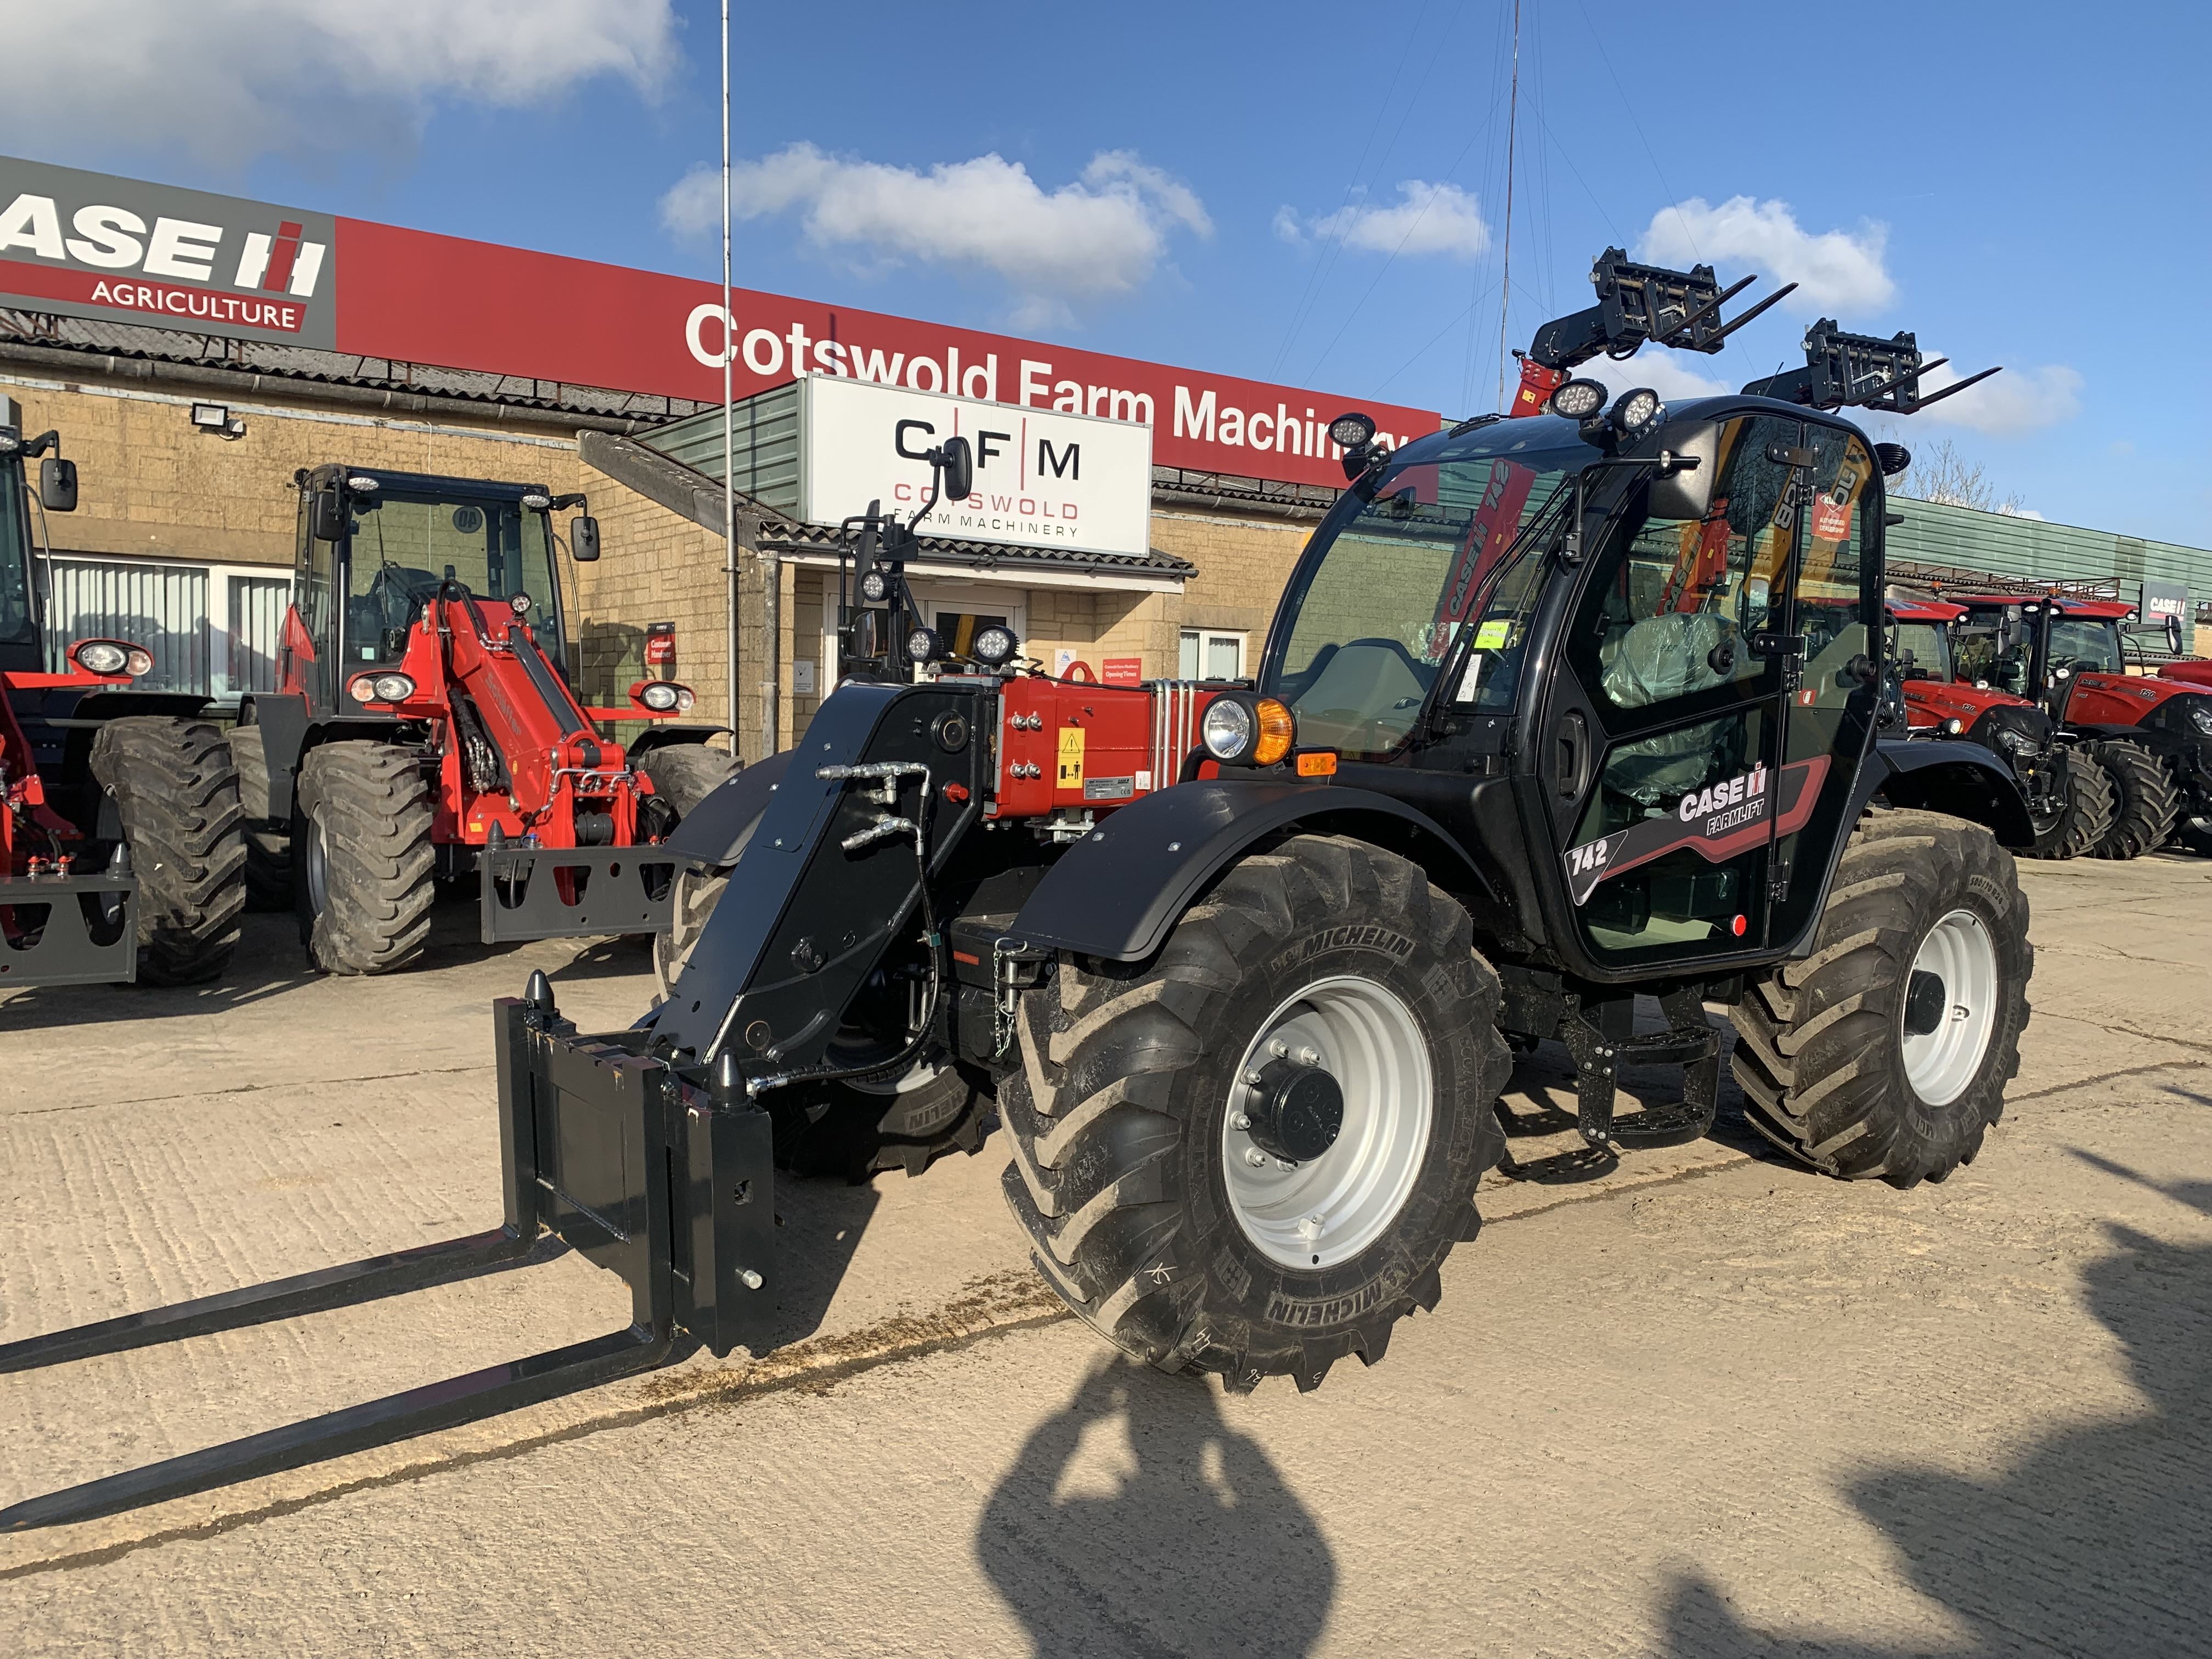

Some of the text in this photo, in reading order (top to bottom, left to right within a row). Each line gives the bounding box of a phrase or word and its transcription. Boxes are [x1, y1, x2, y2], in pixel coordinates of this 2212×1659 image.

[0, 194, 223, 281] ASE
[91, 281, 295, 328] AGRICULTURE
[895, 483, 1077, 520] COSWOLD
[961, 516, 1077, 537] MACHINERY
[1820, 525, 1844, 533] DEALERSHIP
[2150, 597, 2177, 613] CASE
[651, 640, 672, 648] Customer
[651, 650, 671, 658] Handover
[1962, 703, 1976, 712] 130
[2139, 688, 2156, 698] 150
[1679, 776, 1745, 822] CASE
[1706, 798, 1764, 836] FARMLIFT
[1572, 839, 1607, 877] 742
[1302, 926, 1413, 959] MICHELIN
[1268, 1282, 1383, 1328] MICHELIN
